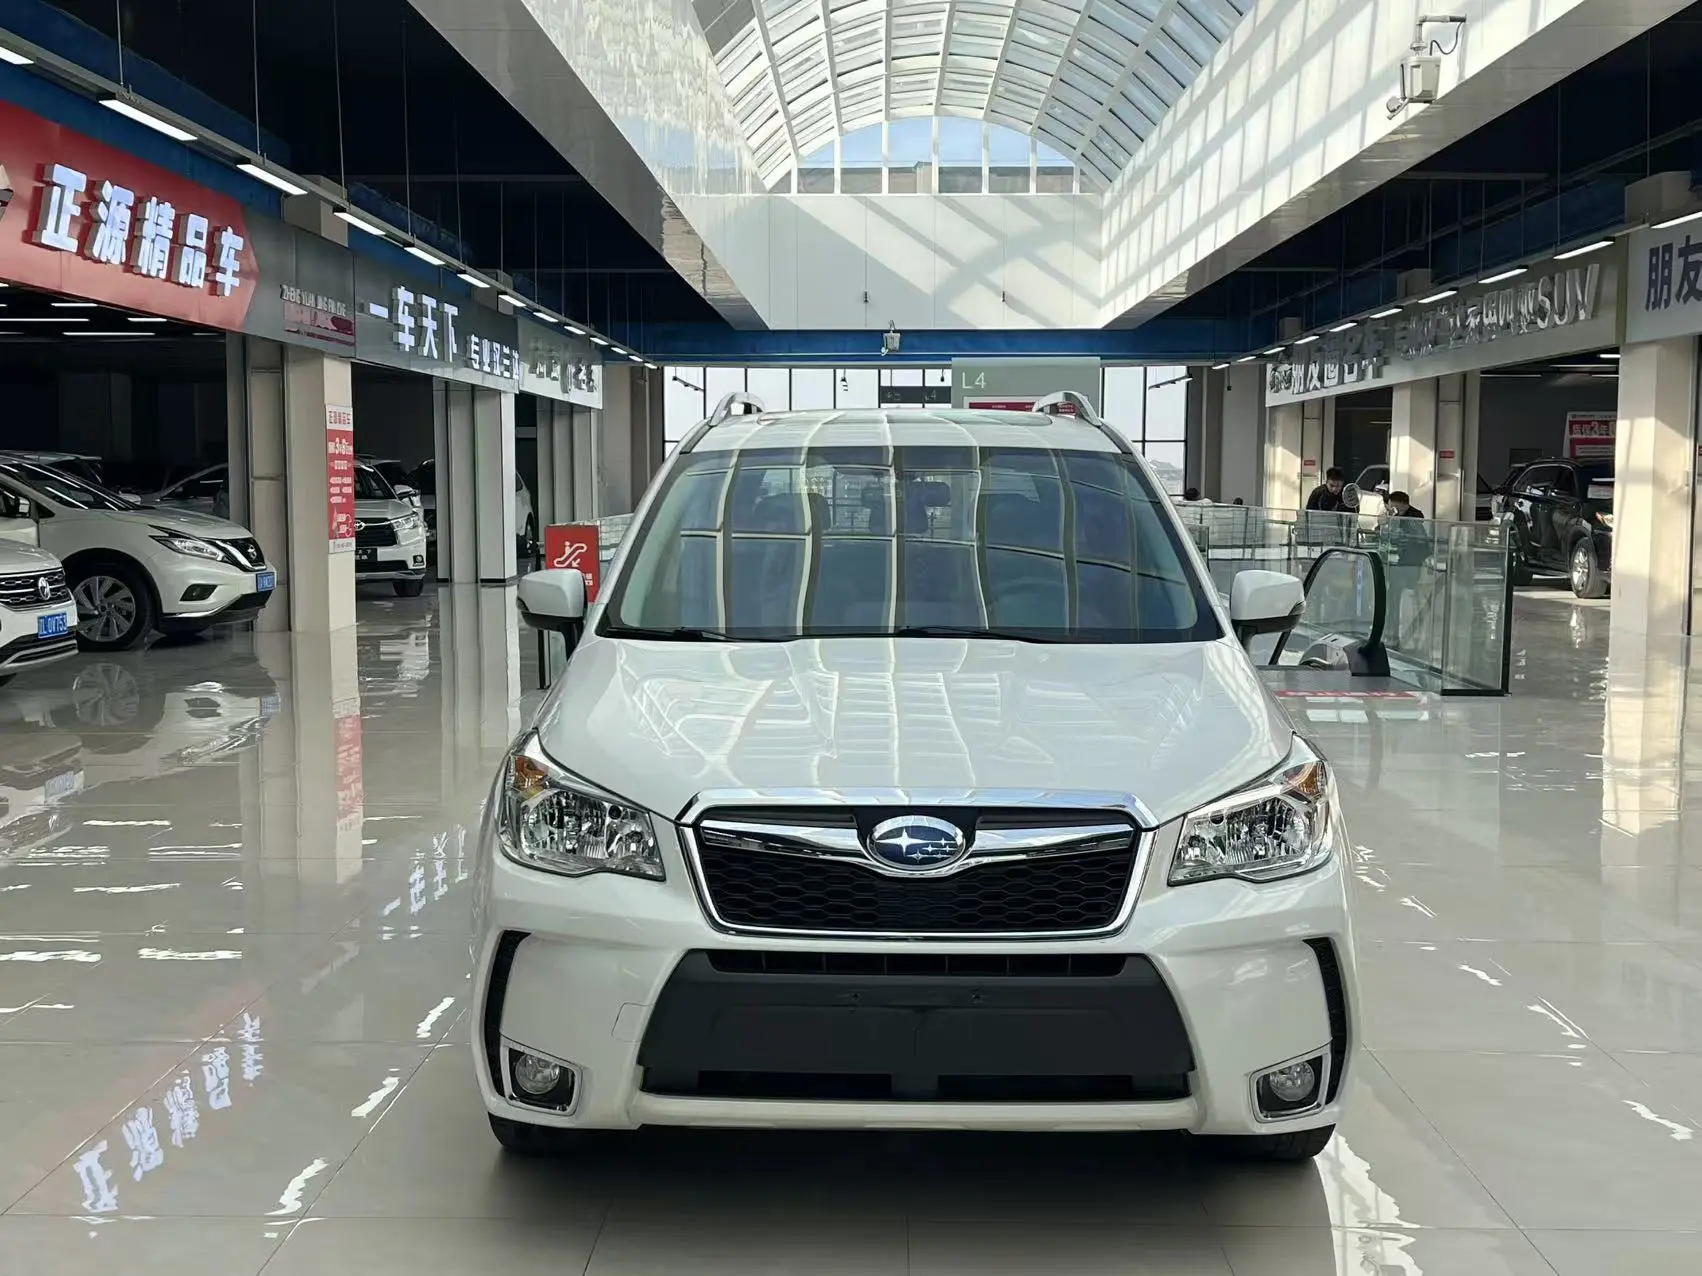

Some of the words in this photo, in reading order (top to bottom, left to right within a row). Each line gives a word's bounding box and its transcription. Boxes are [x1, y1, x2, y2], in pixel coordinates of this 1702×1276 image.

[36, 163, 244, 297] 正源精品车
[369, 286, 459, 363] 一车天下
[961, 371, 987, 389] L4
